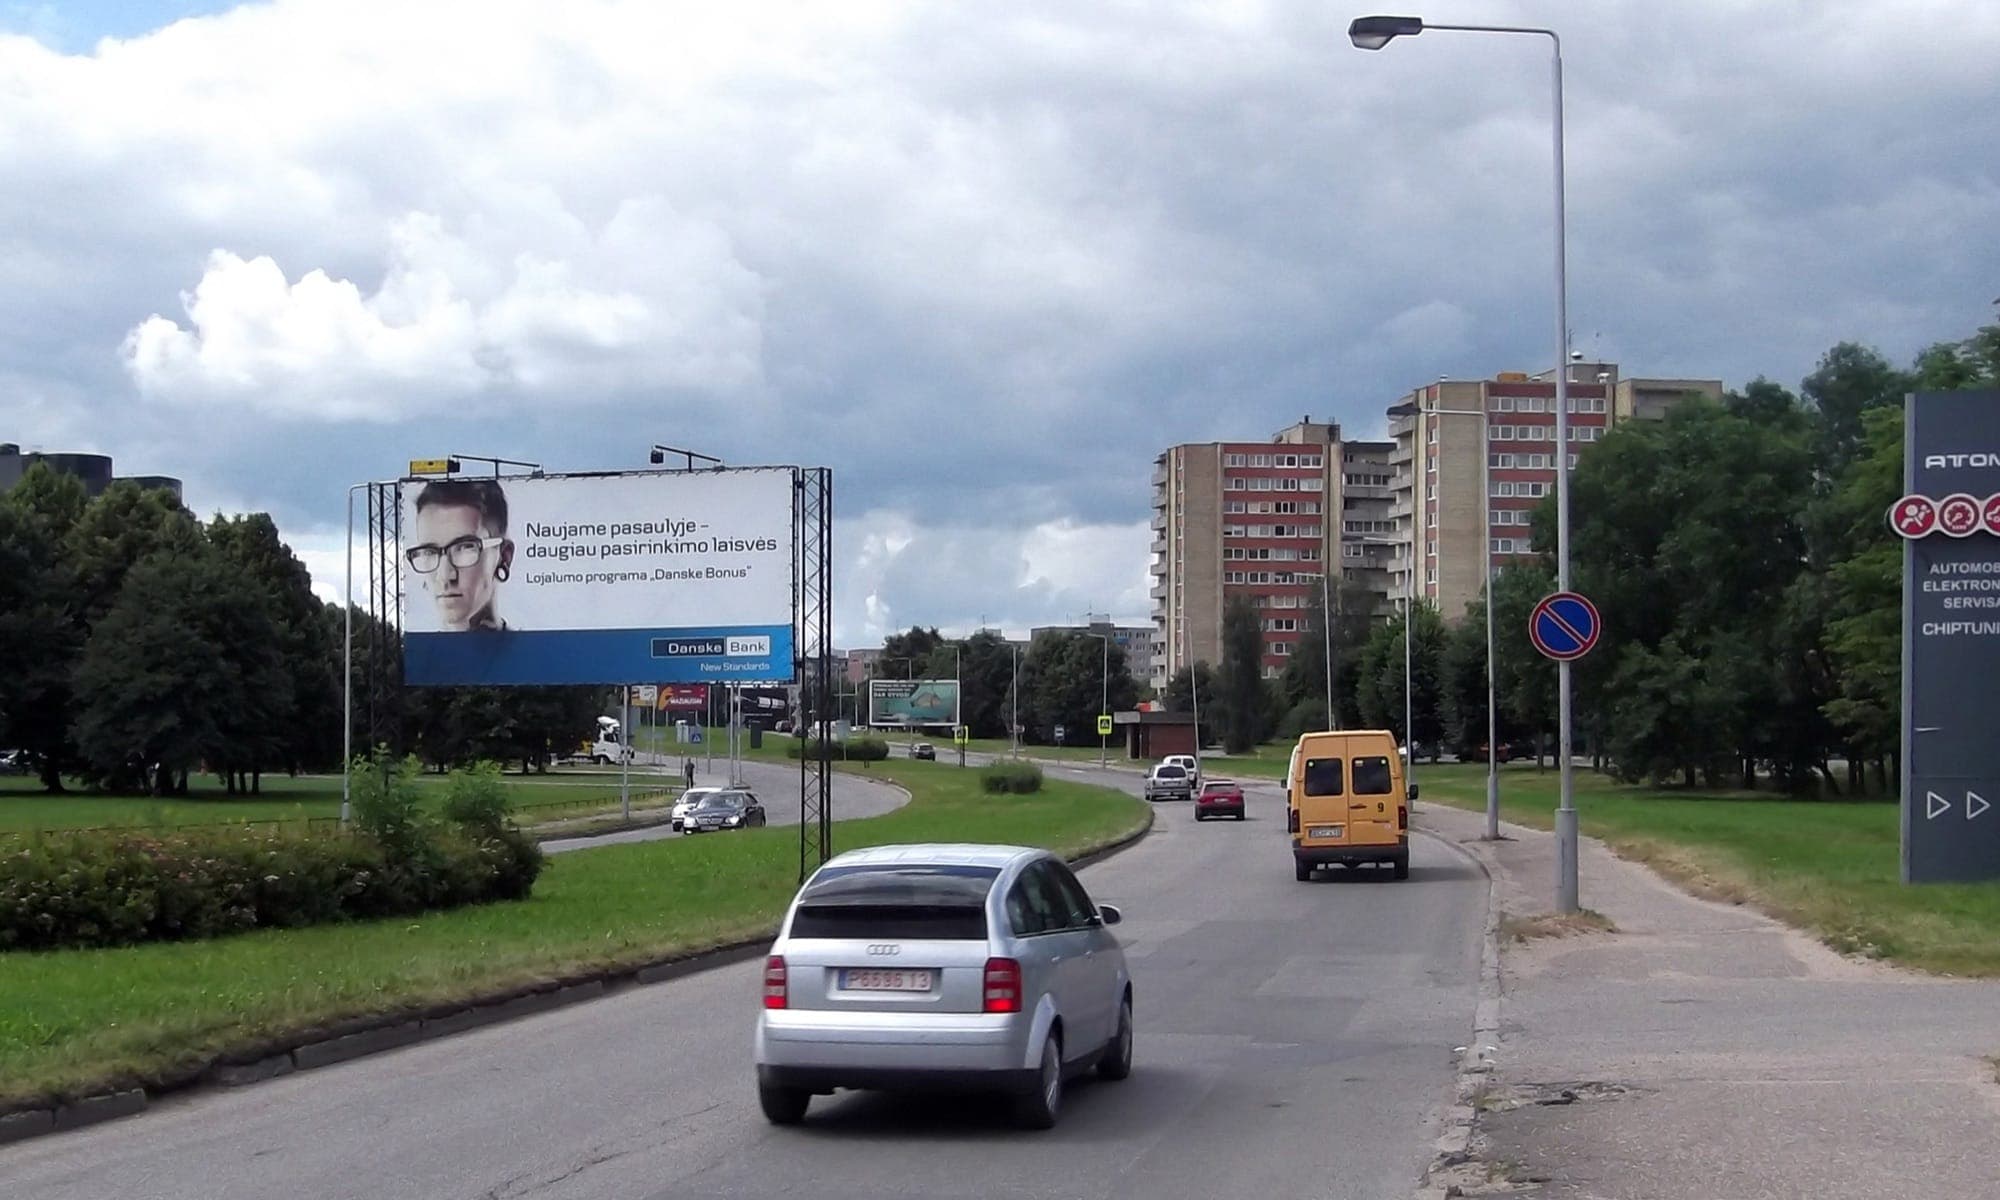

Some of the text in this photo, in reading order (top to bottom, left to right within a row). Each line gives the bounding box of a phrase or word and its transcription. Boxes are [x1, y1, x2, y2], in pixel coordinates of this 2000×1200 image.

[526, 521, 607, 541] Naujame
[610, 518, 697, 539] pasaulyje
[526, 537, 777, 562] daugiau pasirinkimo laisvės
[526, 572, 583, 586] Lojalumo
[585, 571, 648, 585] programa
[668, 641, 766, 654] Danske Bank
[700, 662, 770, 672] New Standards
[1377, 802, 1384, 813] 9
